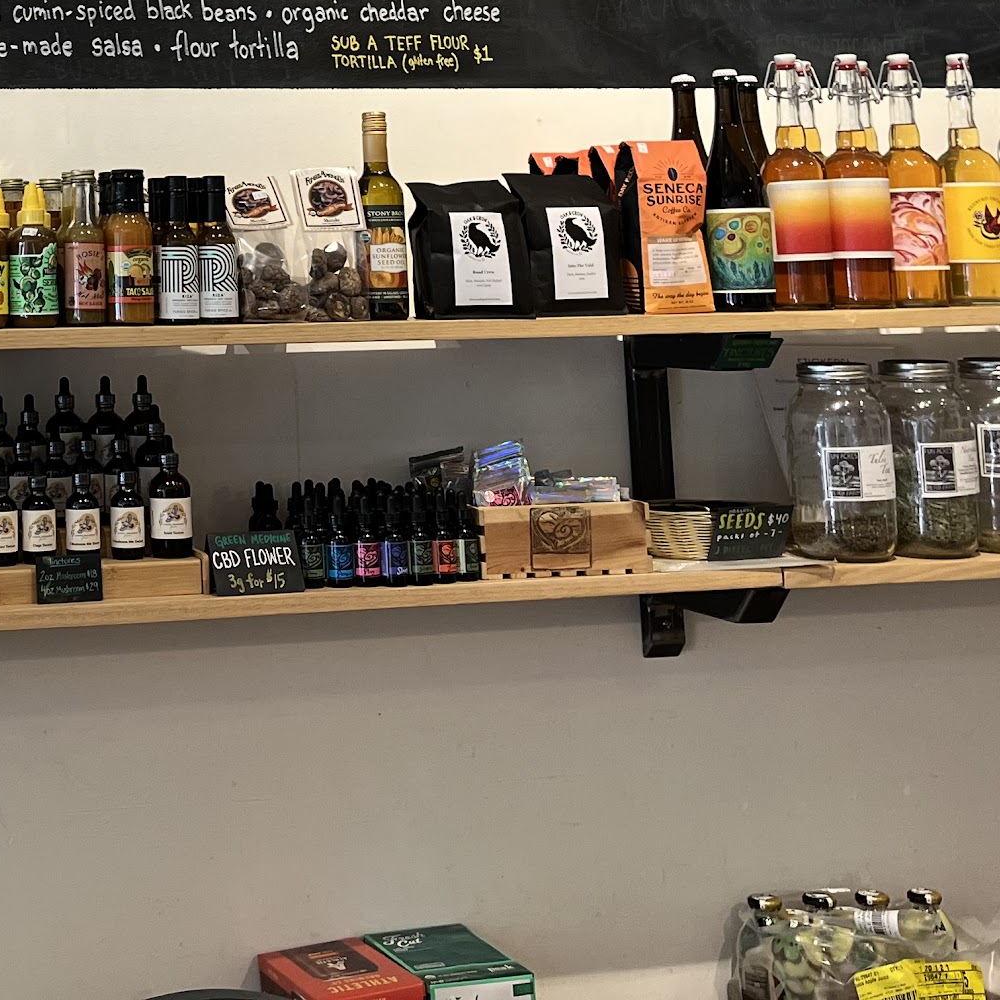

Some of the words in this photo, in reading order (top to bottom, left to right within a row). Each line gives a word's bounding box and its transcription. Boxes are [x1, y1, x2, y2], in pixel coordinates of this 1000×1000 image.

[330, 35, 361, 52] SUB
[366, 36, 378, 52] A
[384, 34, 423, 51] TEFF
[429, 34, 471, 51] FLOUR
[331, 53, 398, 70] TORTILLA
[472, 44, 494, 66] $1
[642, 182, 704, 194] SENECA
[646, 194, 703, 207] SUNRISE
[366, 210, 391, 218] STONY
[718, 512, 766, 530] SEEDS
[767, 512, 790, 527] $40
[214, 534, 246, 548] GREEN
[250, 532, 292, 545] MEDICINE
[716, 532, 746, 543] packs
[212, 550, 241, 570] CBD
[243, 546, 297, 569] FLOWER
[227, 573, 246, 594] 3g
[246, 571, 265, 590] for
[265, 568, 287, 590] $15
[327, 975, 399, 994] ATHLETIC
